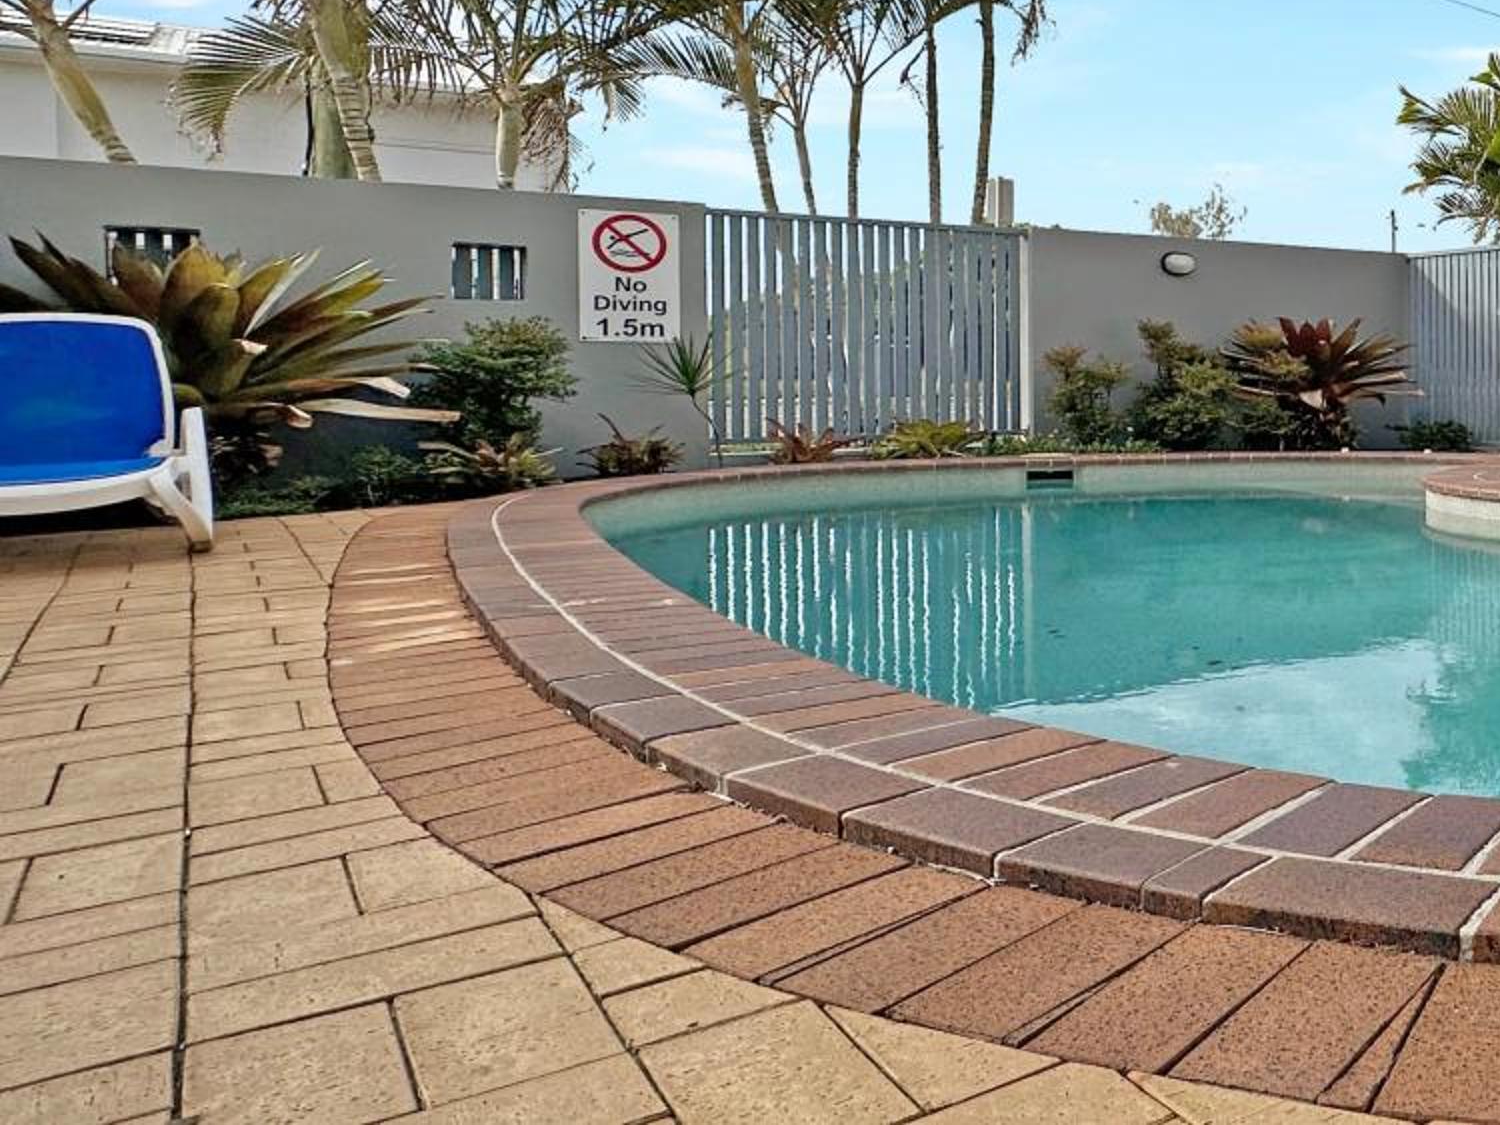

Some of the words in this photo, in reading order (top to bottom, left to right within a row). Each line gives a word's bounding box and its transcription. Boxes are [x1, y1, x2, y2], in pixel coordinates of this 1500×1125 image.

[615, 276, 647, 293] No
[593, 295, 667, 316] Diving
[596, 317, 665, 337] 1.5m
